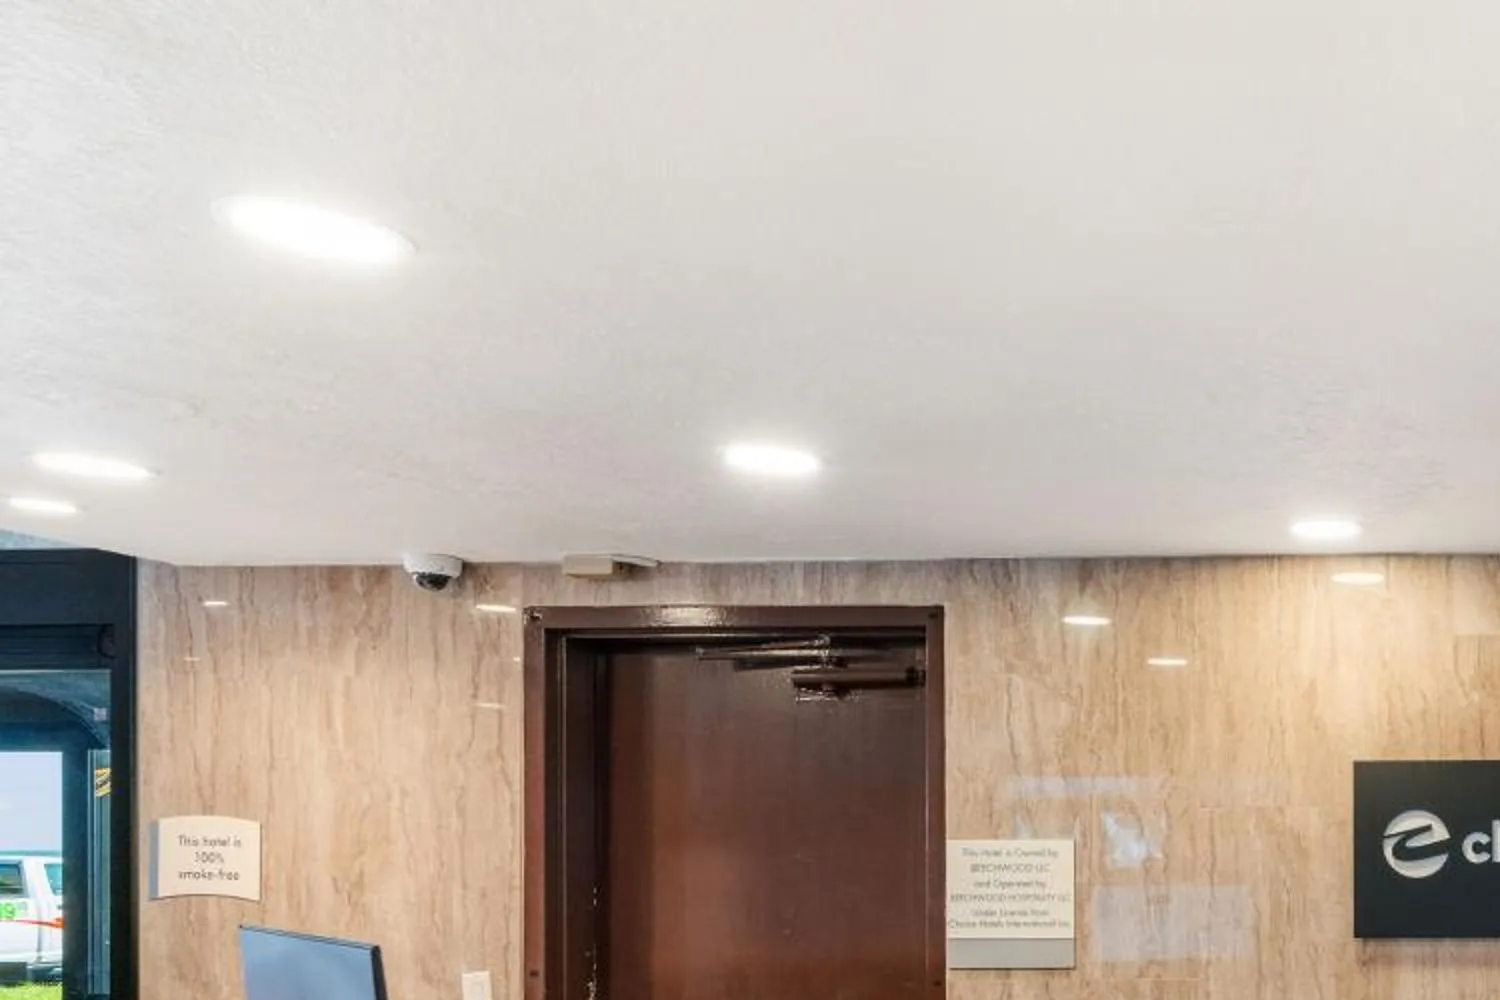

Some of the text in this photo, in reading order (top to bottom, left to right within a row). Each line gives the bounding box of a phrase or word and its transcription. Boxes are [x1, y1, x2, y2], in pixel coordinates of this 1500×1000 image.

[178, 834, 242, 848] This hotel is
[194, 851, 225, 864] 100%
[178, 868, 240, 881] smoke-free
